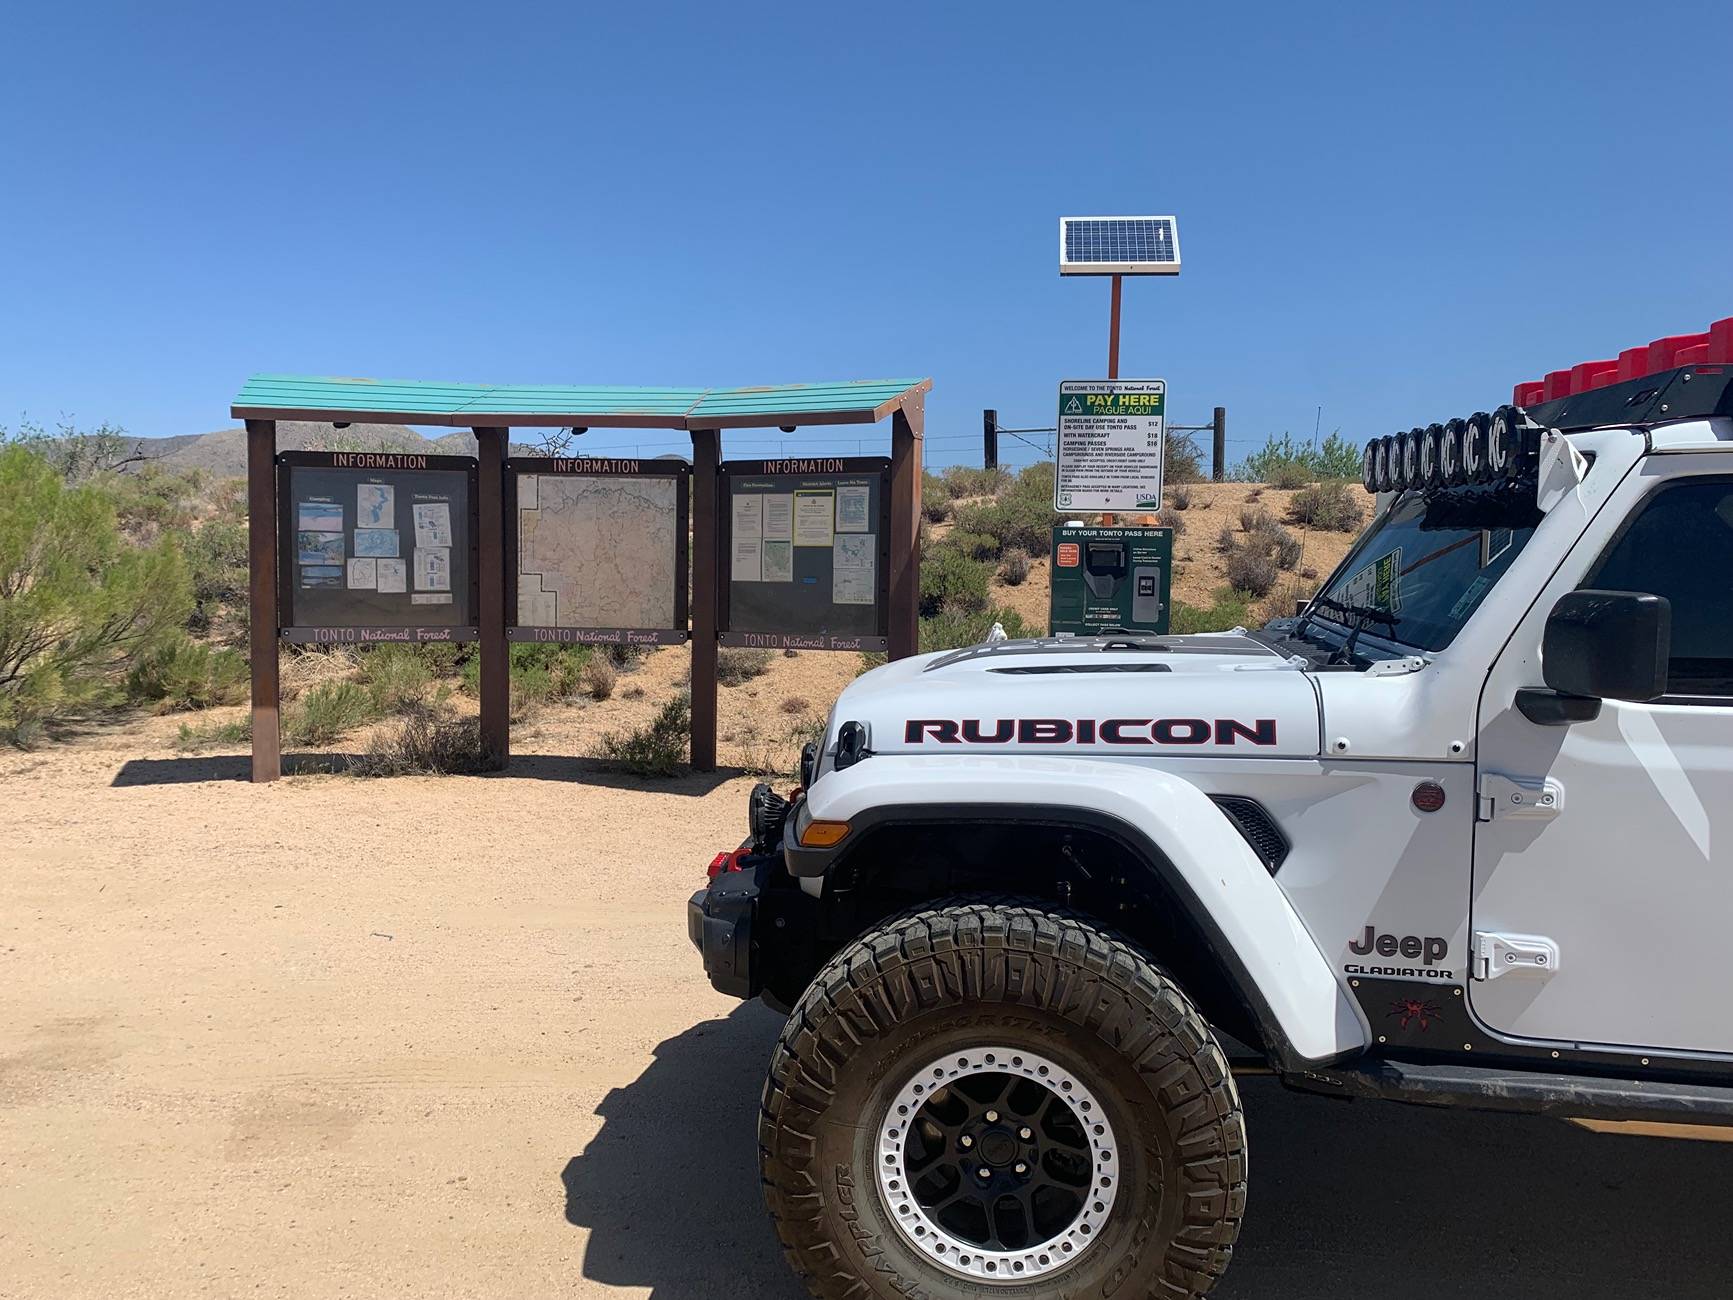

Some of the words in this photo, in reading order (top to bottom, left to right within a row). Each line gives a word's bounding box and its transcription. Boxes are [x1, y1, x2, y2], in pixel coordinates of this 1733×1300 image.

[1087, 395, 1114, 405] PAY
[1119, 395, 1159, 405] HERE
[1463, 423, 1479, 475] KC
[1489, 417, 1506, 472] KC
[334, 454, 426, 468] INFORMATION
[1441, 429, 1455, 478] KC
[554, 460, 639, 473] INFORMATION
[764, 459, 843, 474] INFORMATION
[313, 628, 355, 641] TONTO
[361, 628, 410, 641] National
[416, 628, 451, 641] Forest
[534, 629, 570, 642] TONTO
[576, 629, 620, 642] National
[627, 629, 658, 642] Forest
[744, 634, 777, 648] TONTO
[783, 634, 824, 648] National
[830, 634, 861, 648] Forest
[904, 718, 1278, 746] RUBICON
[1348, 926, 1448, 965] Jeep
[1344, 964, 1453, 979] GLADIATOR
